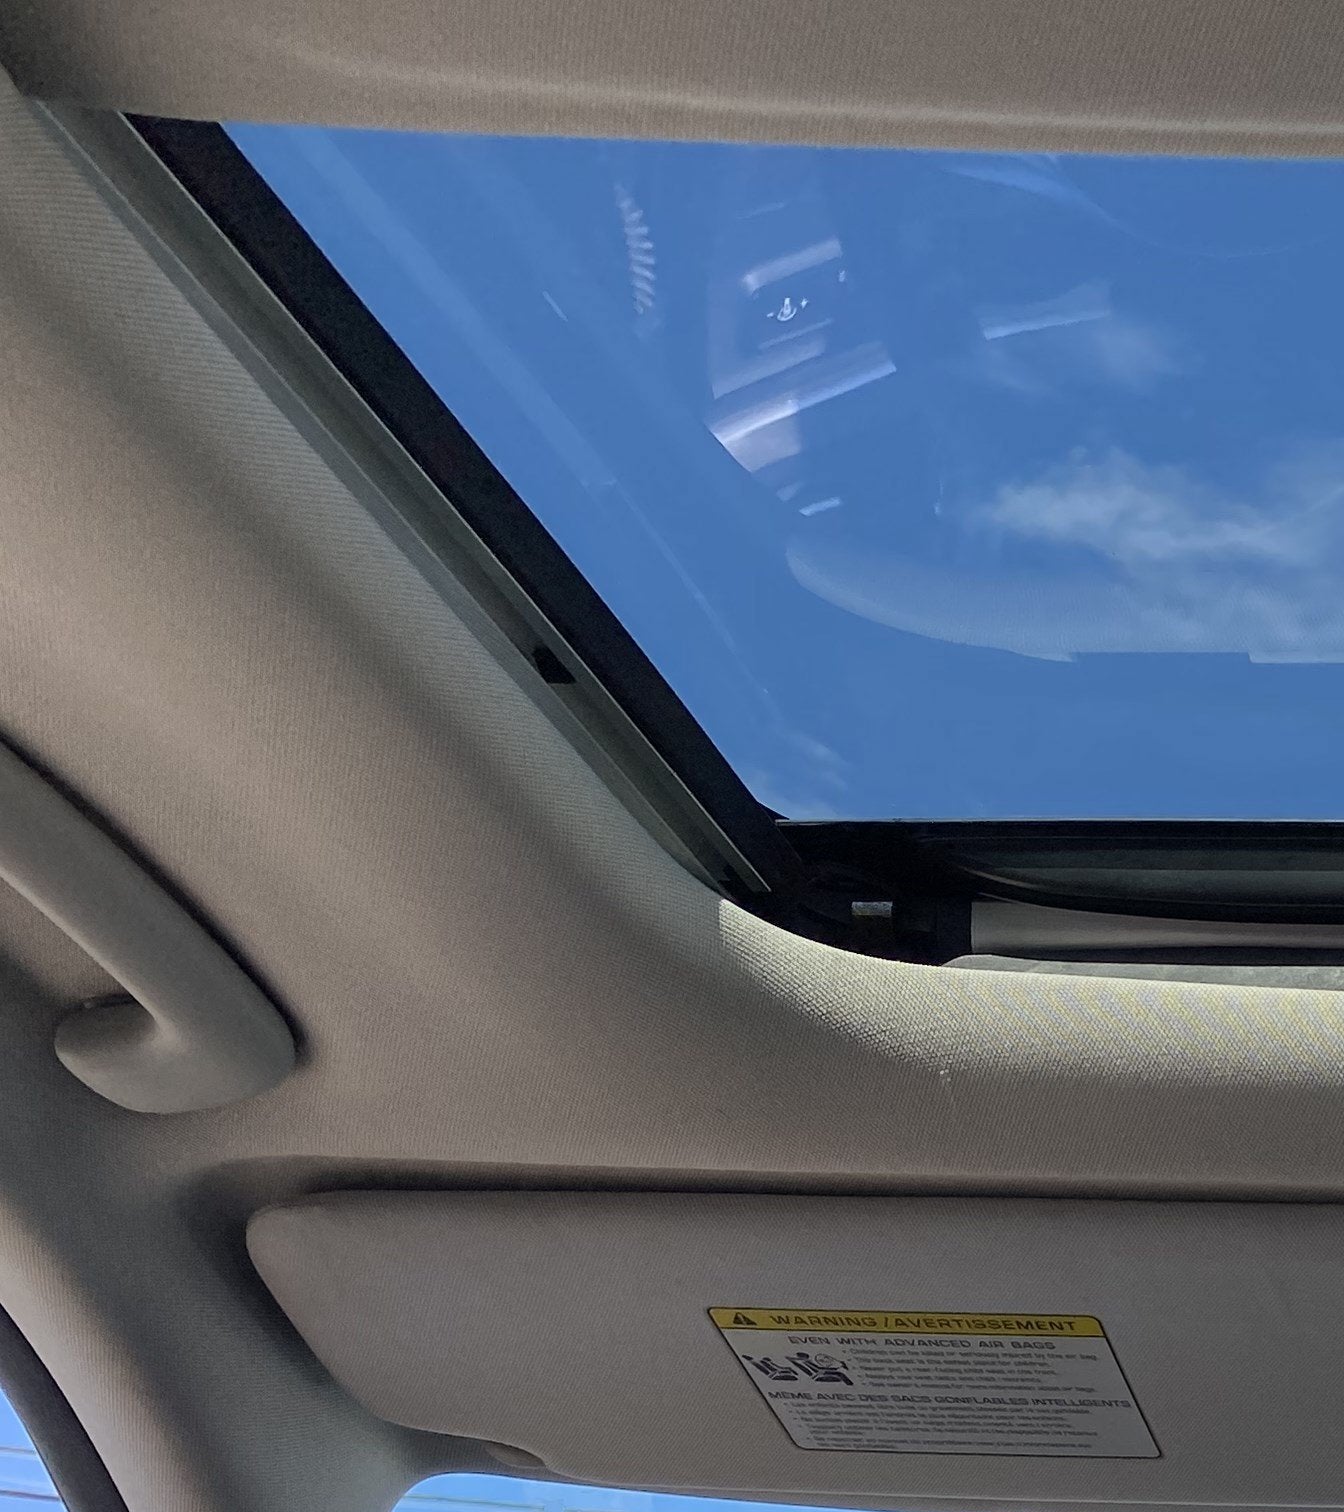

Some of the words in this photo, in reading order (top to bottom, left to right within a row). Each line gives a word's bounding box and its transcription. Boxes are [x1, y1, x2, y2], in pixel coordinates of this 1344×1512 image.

[770, 1314, 877, 1329] WARNING
[894, 1317, 1077, 1333] AVERTISSEMENT
[788, 1336, 830, 1346] EVEN
[835, 1337, 878, 1347] WITH
[884, 1338, 971, 1349] ADVANCED
[979, 1340, 1005, 1350] AIR
[1011, 1341, 1056, 1351] BAGS
[816, 1392, 854, 1403] AVEC
